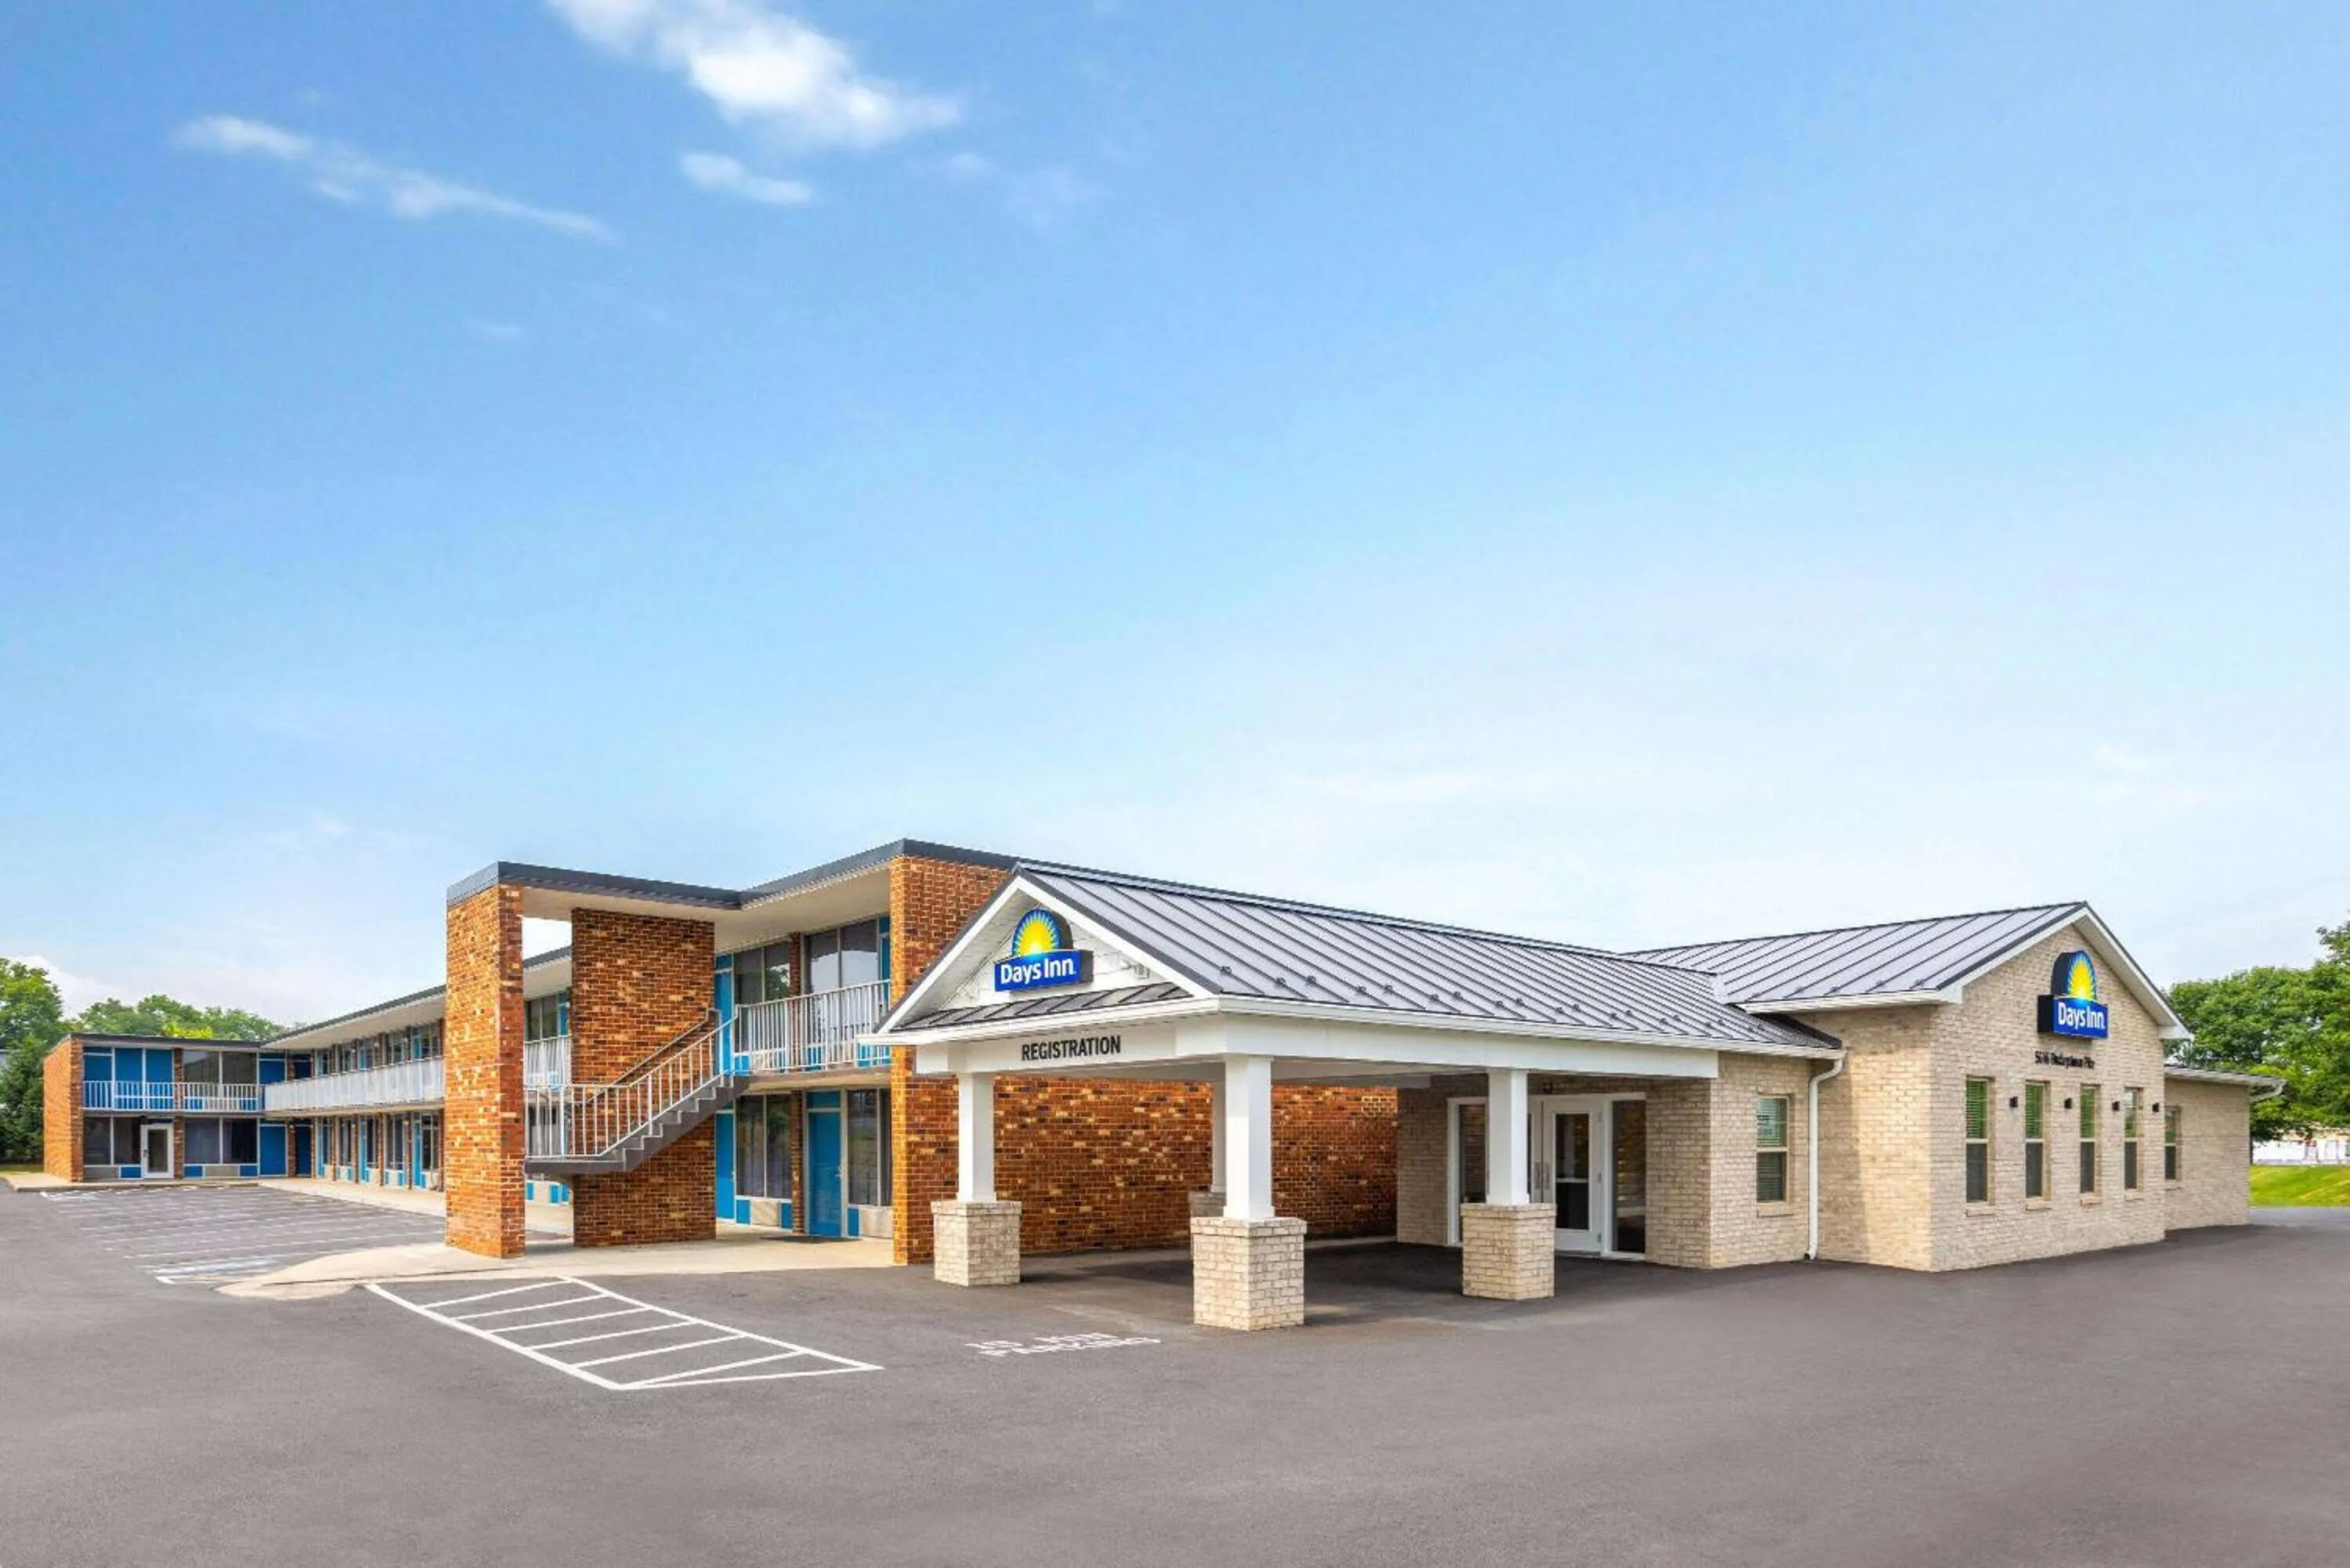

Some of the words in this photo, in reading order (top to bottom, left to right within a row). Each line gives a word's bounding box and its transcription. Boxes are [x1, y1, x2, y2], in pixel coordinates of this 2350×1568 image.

[1000, 963, 1041, 985] Days
[1044, 958, 1074, 977] Inn
[2058, 1002, 2085, 1030] Days
[2087, 1006, 2104, 1029] Inn
[1021, 1035, 1122, 1061] REGISTRATION
